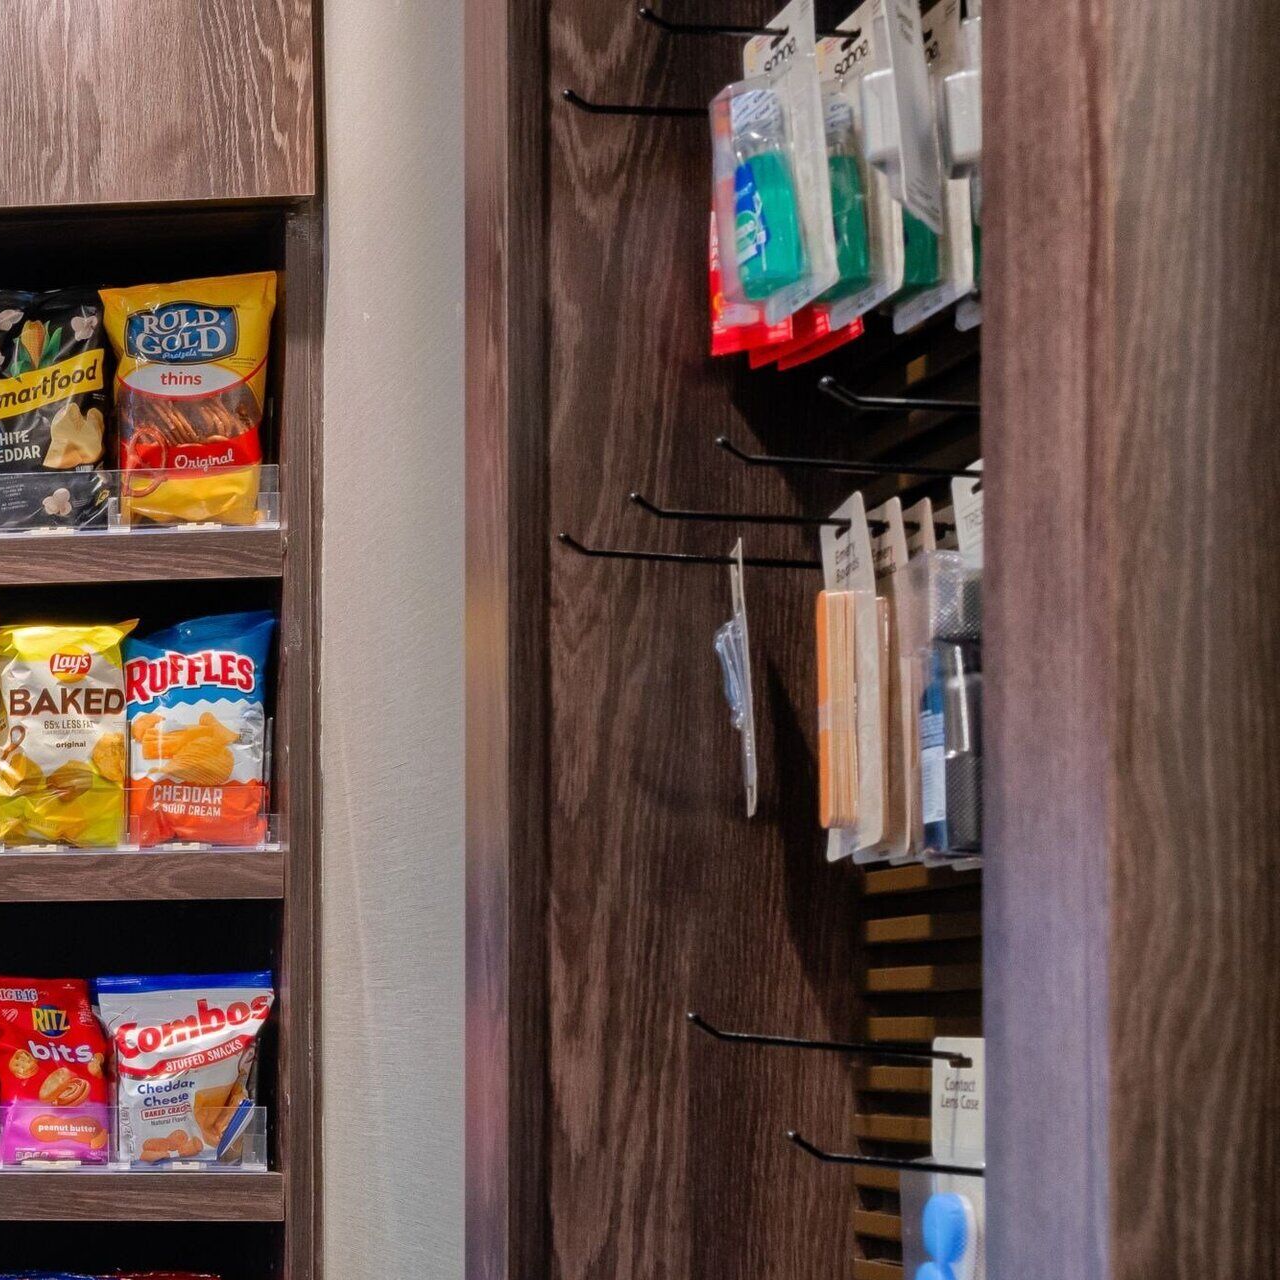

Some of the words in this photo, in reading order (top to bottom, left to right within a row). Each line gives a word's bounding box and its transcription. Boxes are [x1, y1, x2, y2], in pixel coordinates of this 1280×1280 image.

[142, 308, 220, 335] ROLD
[136, 324, 228, 354] GOLD
[160, 371, 203, 387] thins
[174, 449, 235, 473] Original
[51, 653, 90, 674] Lay's
[125, 651, 255, 703] RUFFLES
[9, 688, 125, 717] BAKED
[44, 720, 60, 730] 65%
[62, 719, 80, 730] LESS
[55, 740, 87, 750] original
[152, 785, 223, 806] CHEDDAR
[188, 805, 221, 817] CREAM
[31, 1008, 71, 1031] RITZ
[113, 995, 273, 1060] Combos
[27, 1038, 95, 1063] bits
[165, 1052, 206, 1073] STUFFED
[206, 1040, 245, 1064] SNACKS
[136, 1078, 196, 1096] Cheddar
[944, 1077, 976, 1092] Contact
[143, 1090, 190, 1107] Cheese
[941, 1095, 959, 1108] Lens
[959, 1095, 979, 1111] Case
[38, 1122, 69, 1134] peanut
[69, 1122, 97, 1133] butter
